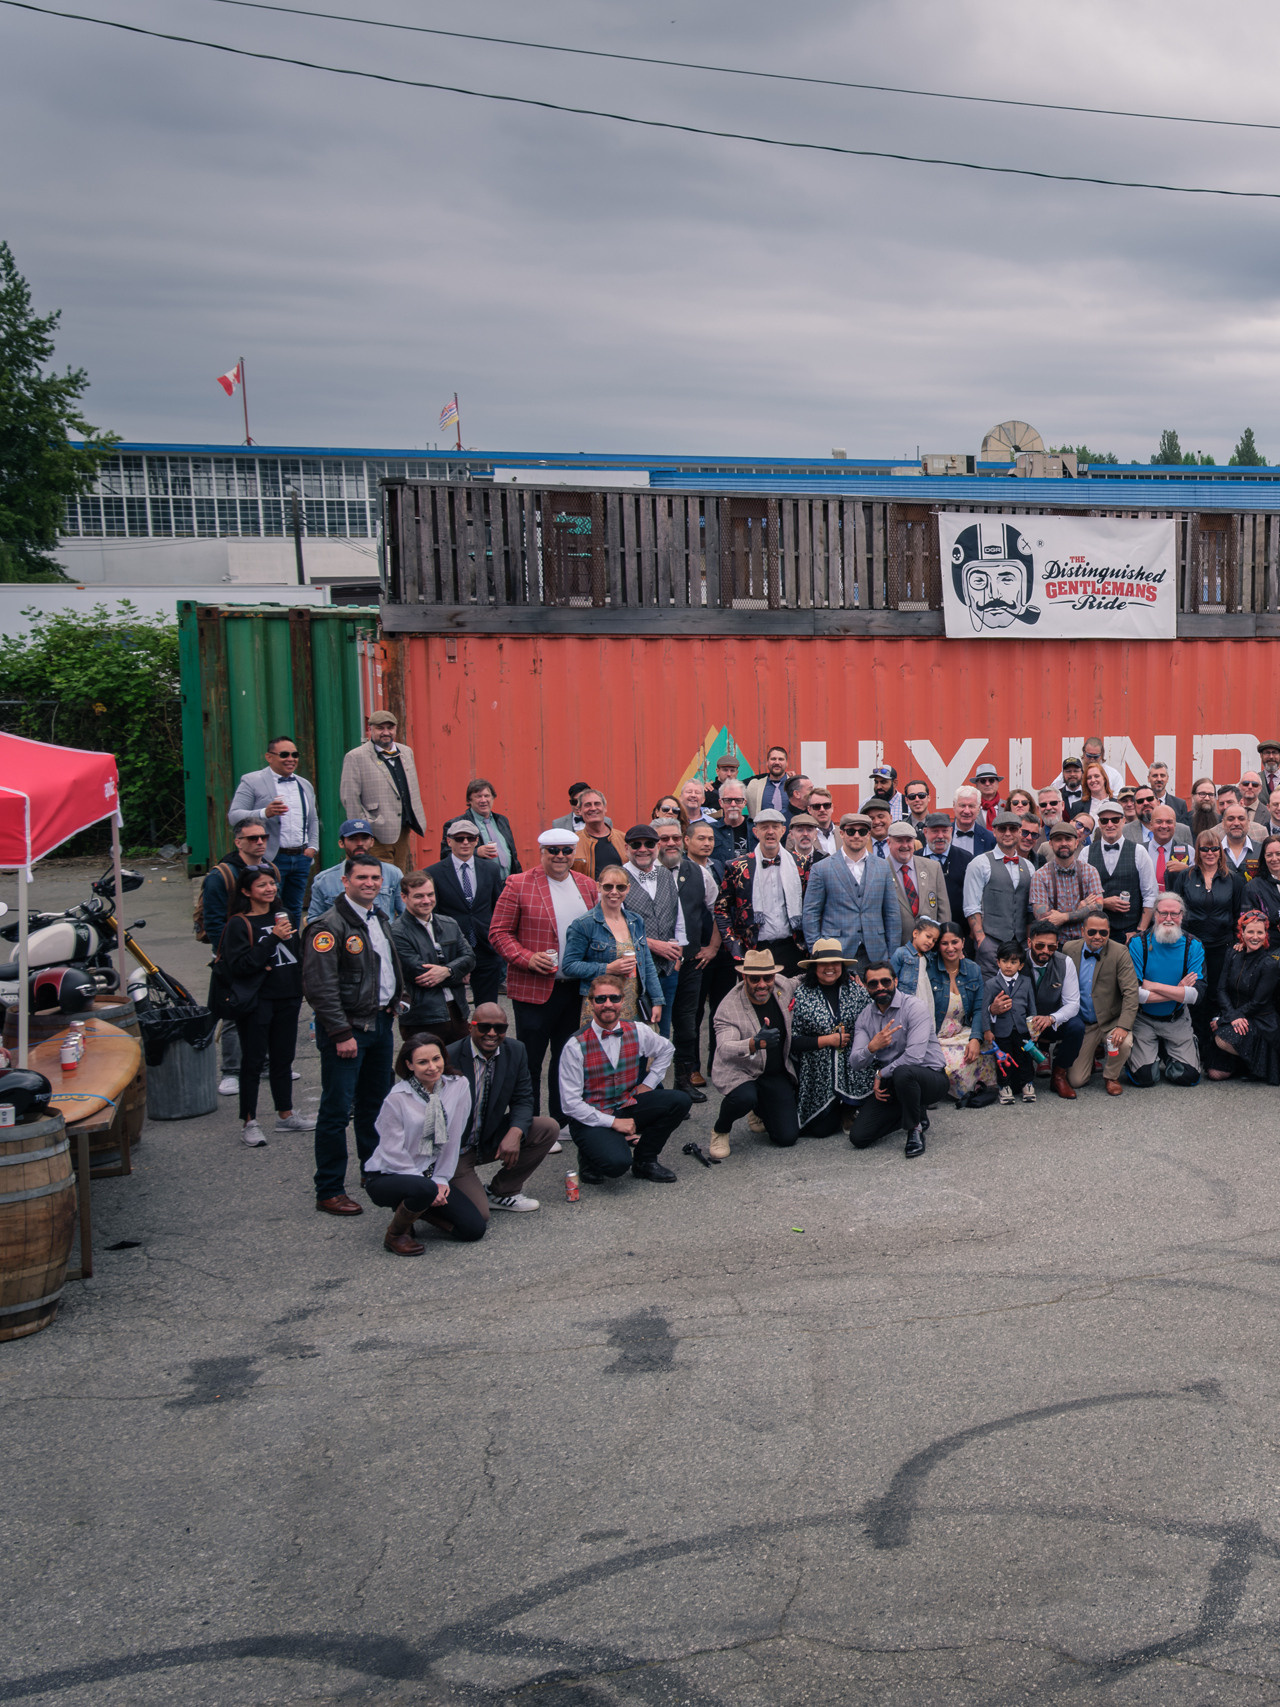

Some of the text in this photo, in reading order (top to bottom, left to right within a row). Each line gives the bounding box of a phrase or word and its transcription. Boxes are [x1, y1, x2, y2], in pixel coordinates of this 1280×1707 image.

[1041, 560, 1166, 584] Distinguished
[1045, 581, 1158, 602] GENTLEMAN'S
[1071, 594, 1128, 611] Ride
